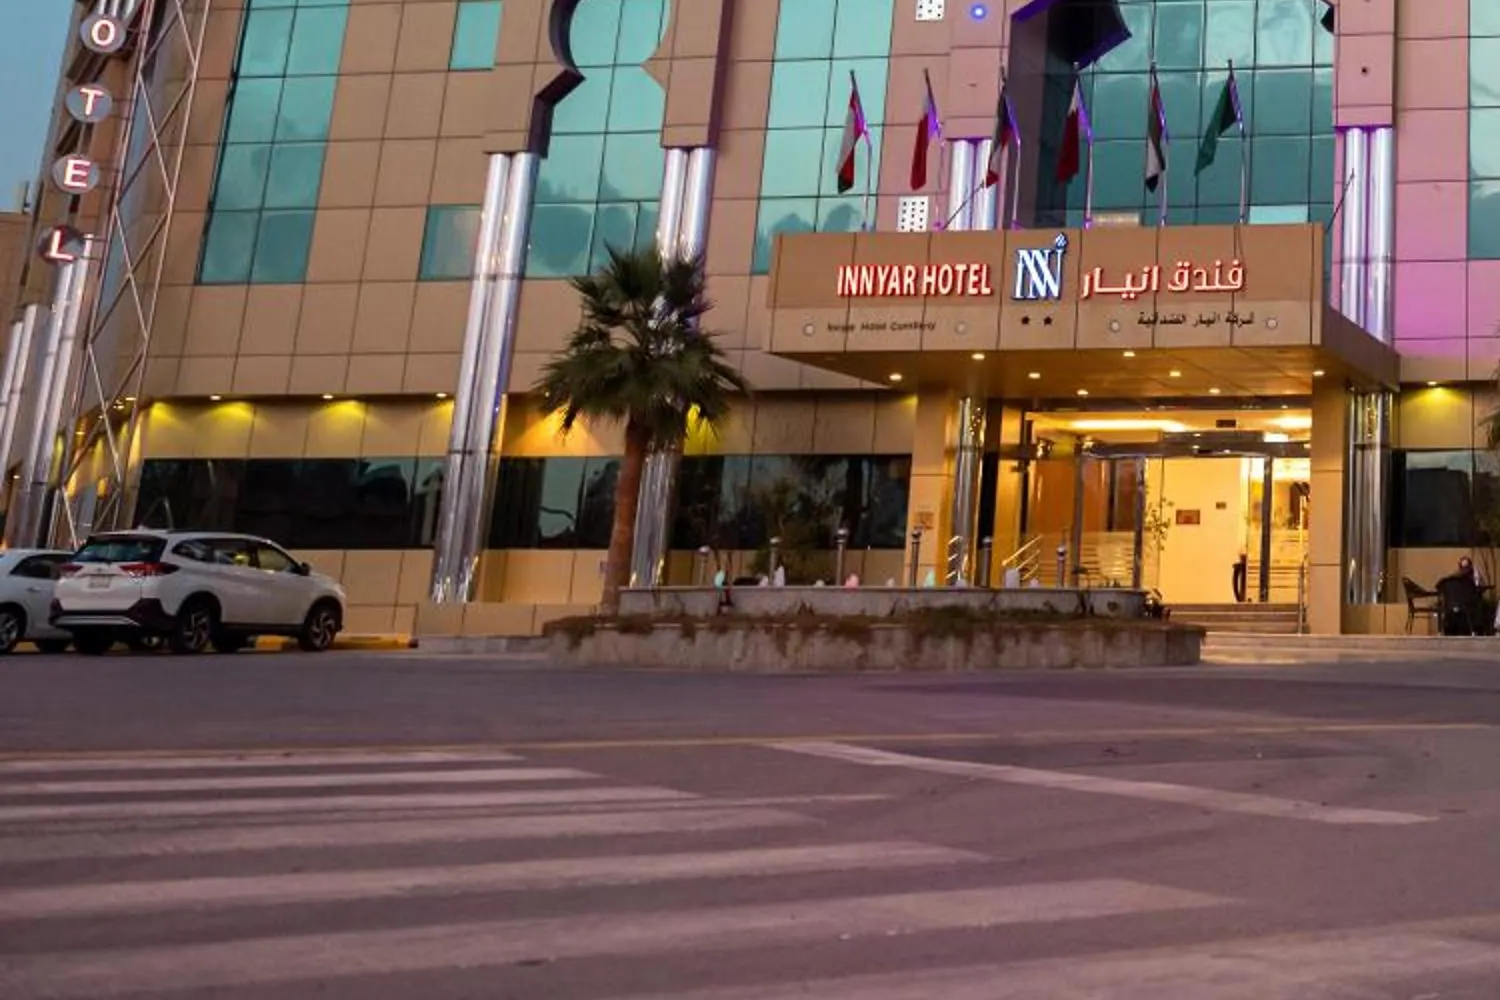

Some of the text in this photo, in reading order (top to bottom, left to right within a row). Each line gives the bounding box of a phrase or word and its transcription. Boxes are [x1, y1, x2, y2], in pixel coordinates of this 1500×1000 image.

[837, 263, 992, 297] INNYAR HOTEL
[1167, 258, 1245, 292] فندق
